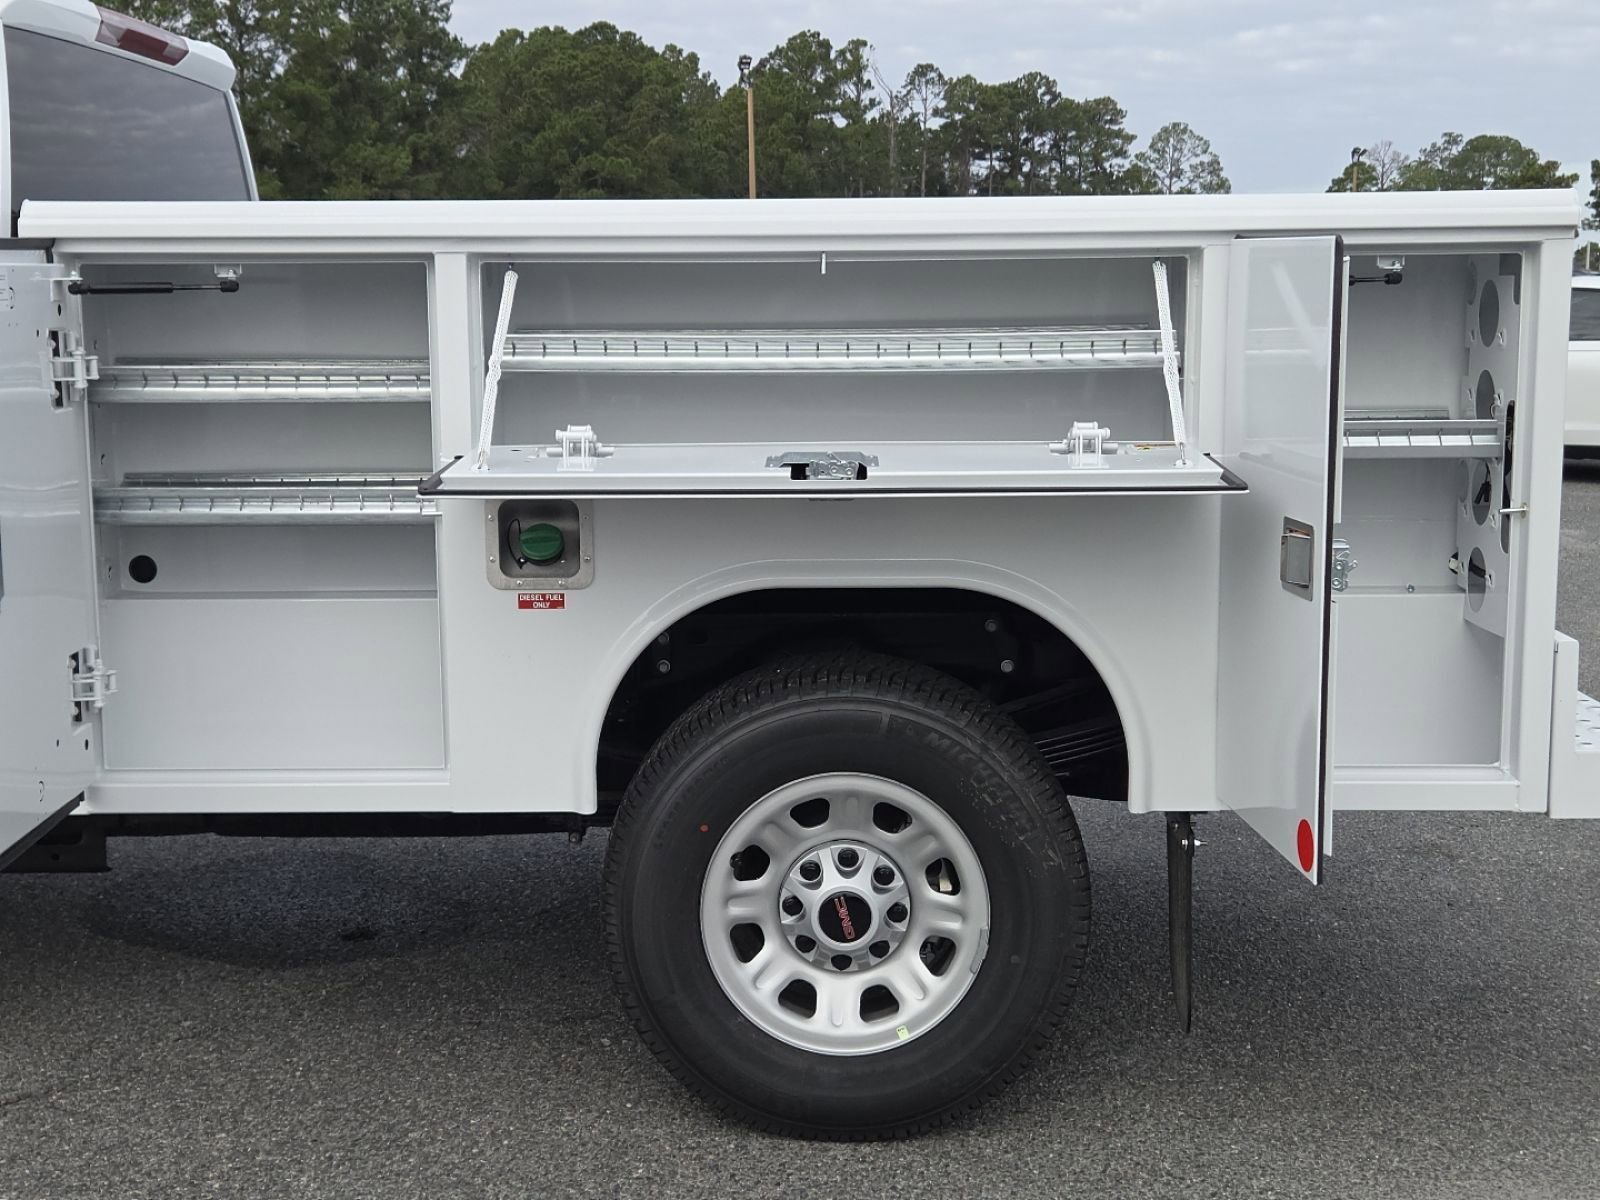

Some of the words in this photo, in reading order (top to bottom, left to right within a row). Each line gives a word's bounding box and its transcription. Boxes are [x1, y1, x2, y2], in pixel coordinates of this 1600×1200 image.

[520, 593, 544, 601] DIESEL
[545, 593, 563, 601] FUEL
[532, 601, 550, 609] ONLY
[833, 896, 856, 940] GMC
